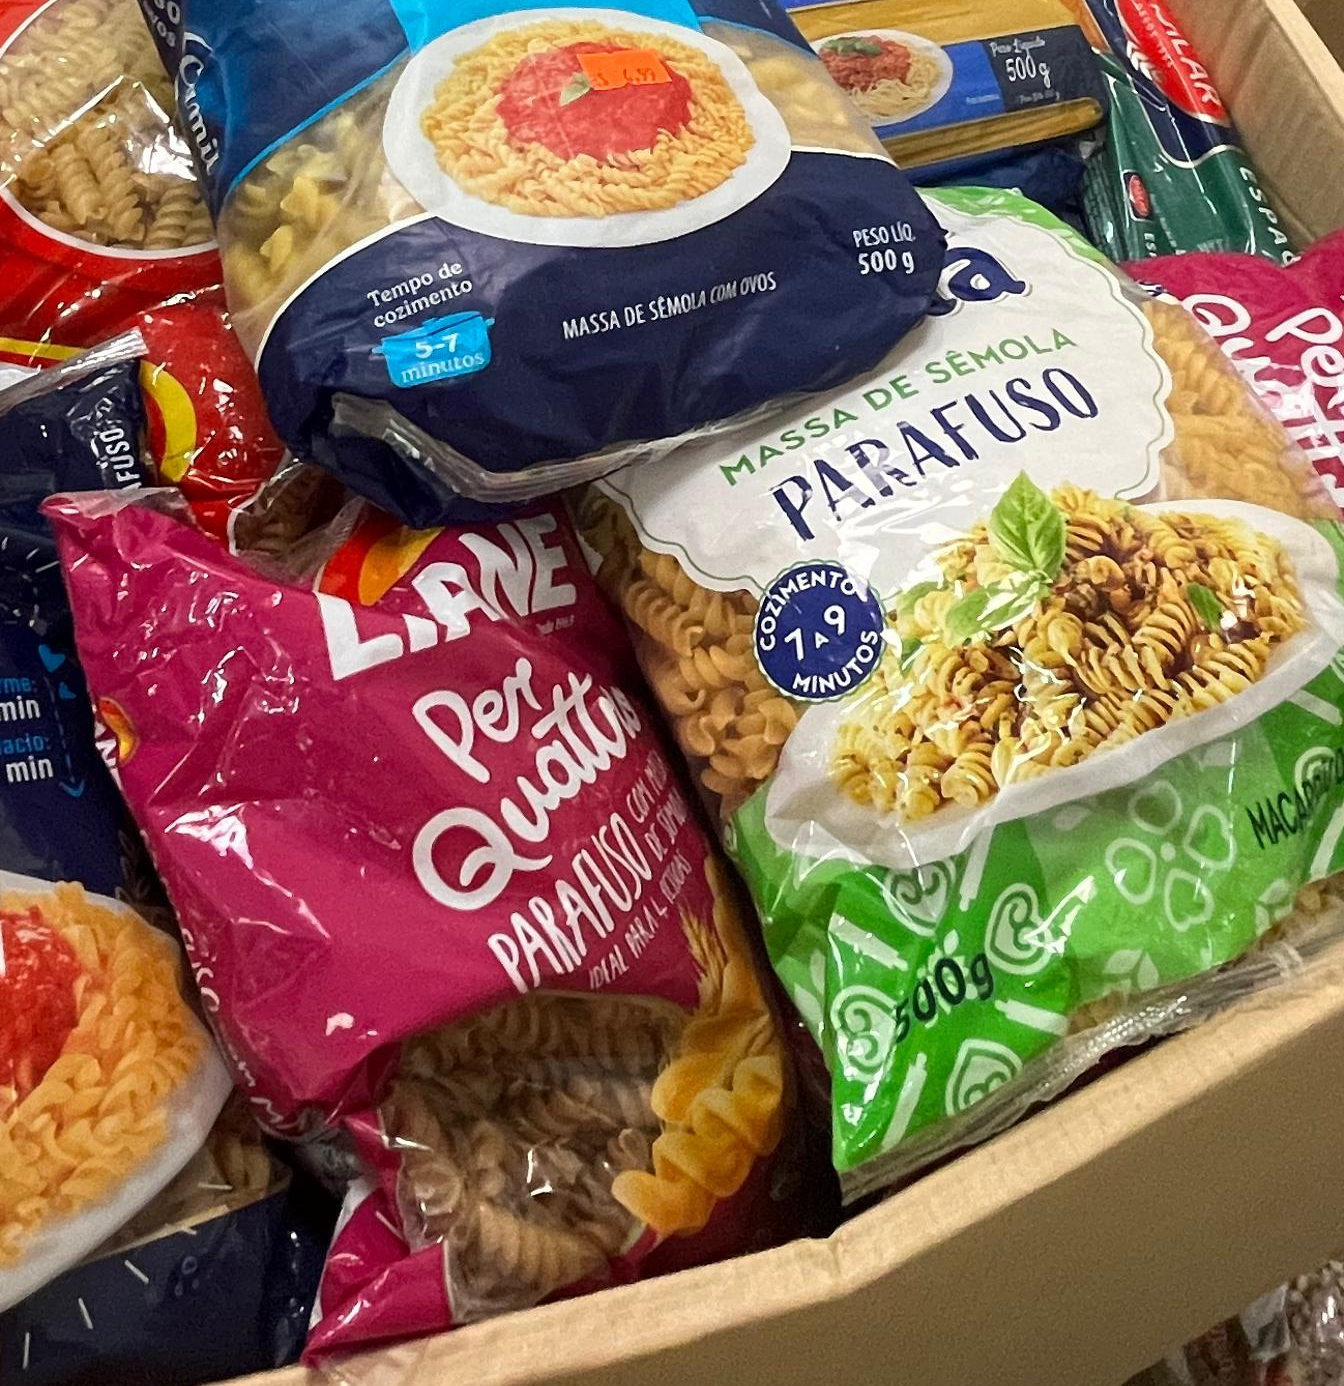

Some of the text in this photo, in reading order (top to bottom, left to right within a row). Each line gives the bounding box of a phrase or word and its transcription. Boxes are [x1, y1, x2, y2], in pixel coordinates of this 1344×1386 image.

[1006, 55, 1052, 90] 500 g
[178, 54, 221, 177] Camil
[852, 226, 890, 249] PESO
[857, 250, 916, 276] 500 g
[367, 260, 464, 310] Tempo de
[372, 276, 475, 330] cozimento
[561, 270, 778, 341] MASSA DE SÊMOLA COM OVOS
[400, 349, 486, 385] minutos
[414, 333, 459, 359] 5-7
[717, 328, 1078, 487] MASSA DE SÊMOLA
[769, 367, 1100, 542] PARAFUSO
[313, 514, 579, 681] LIANE
[759, 569, 858, 652] COZIMENTO
[783, 604, 847, 662] 7 A 9
[792, 630, 879, 694] MINUTOS
[410, 657, 544, 784] Per
[4, 754, 55, 784] min
[411, 672, 644, 912] Quattro
[487, 811, 653, 995] PARAFUSO
[588, 943, 631, 991] IDEAL
[895, 952, 995, 1044] 500g
